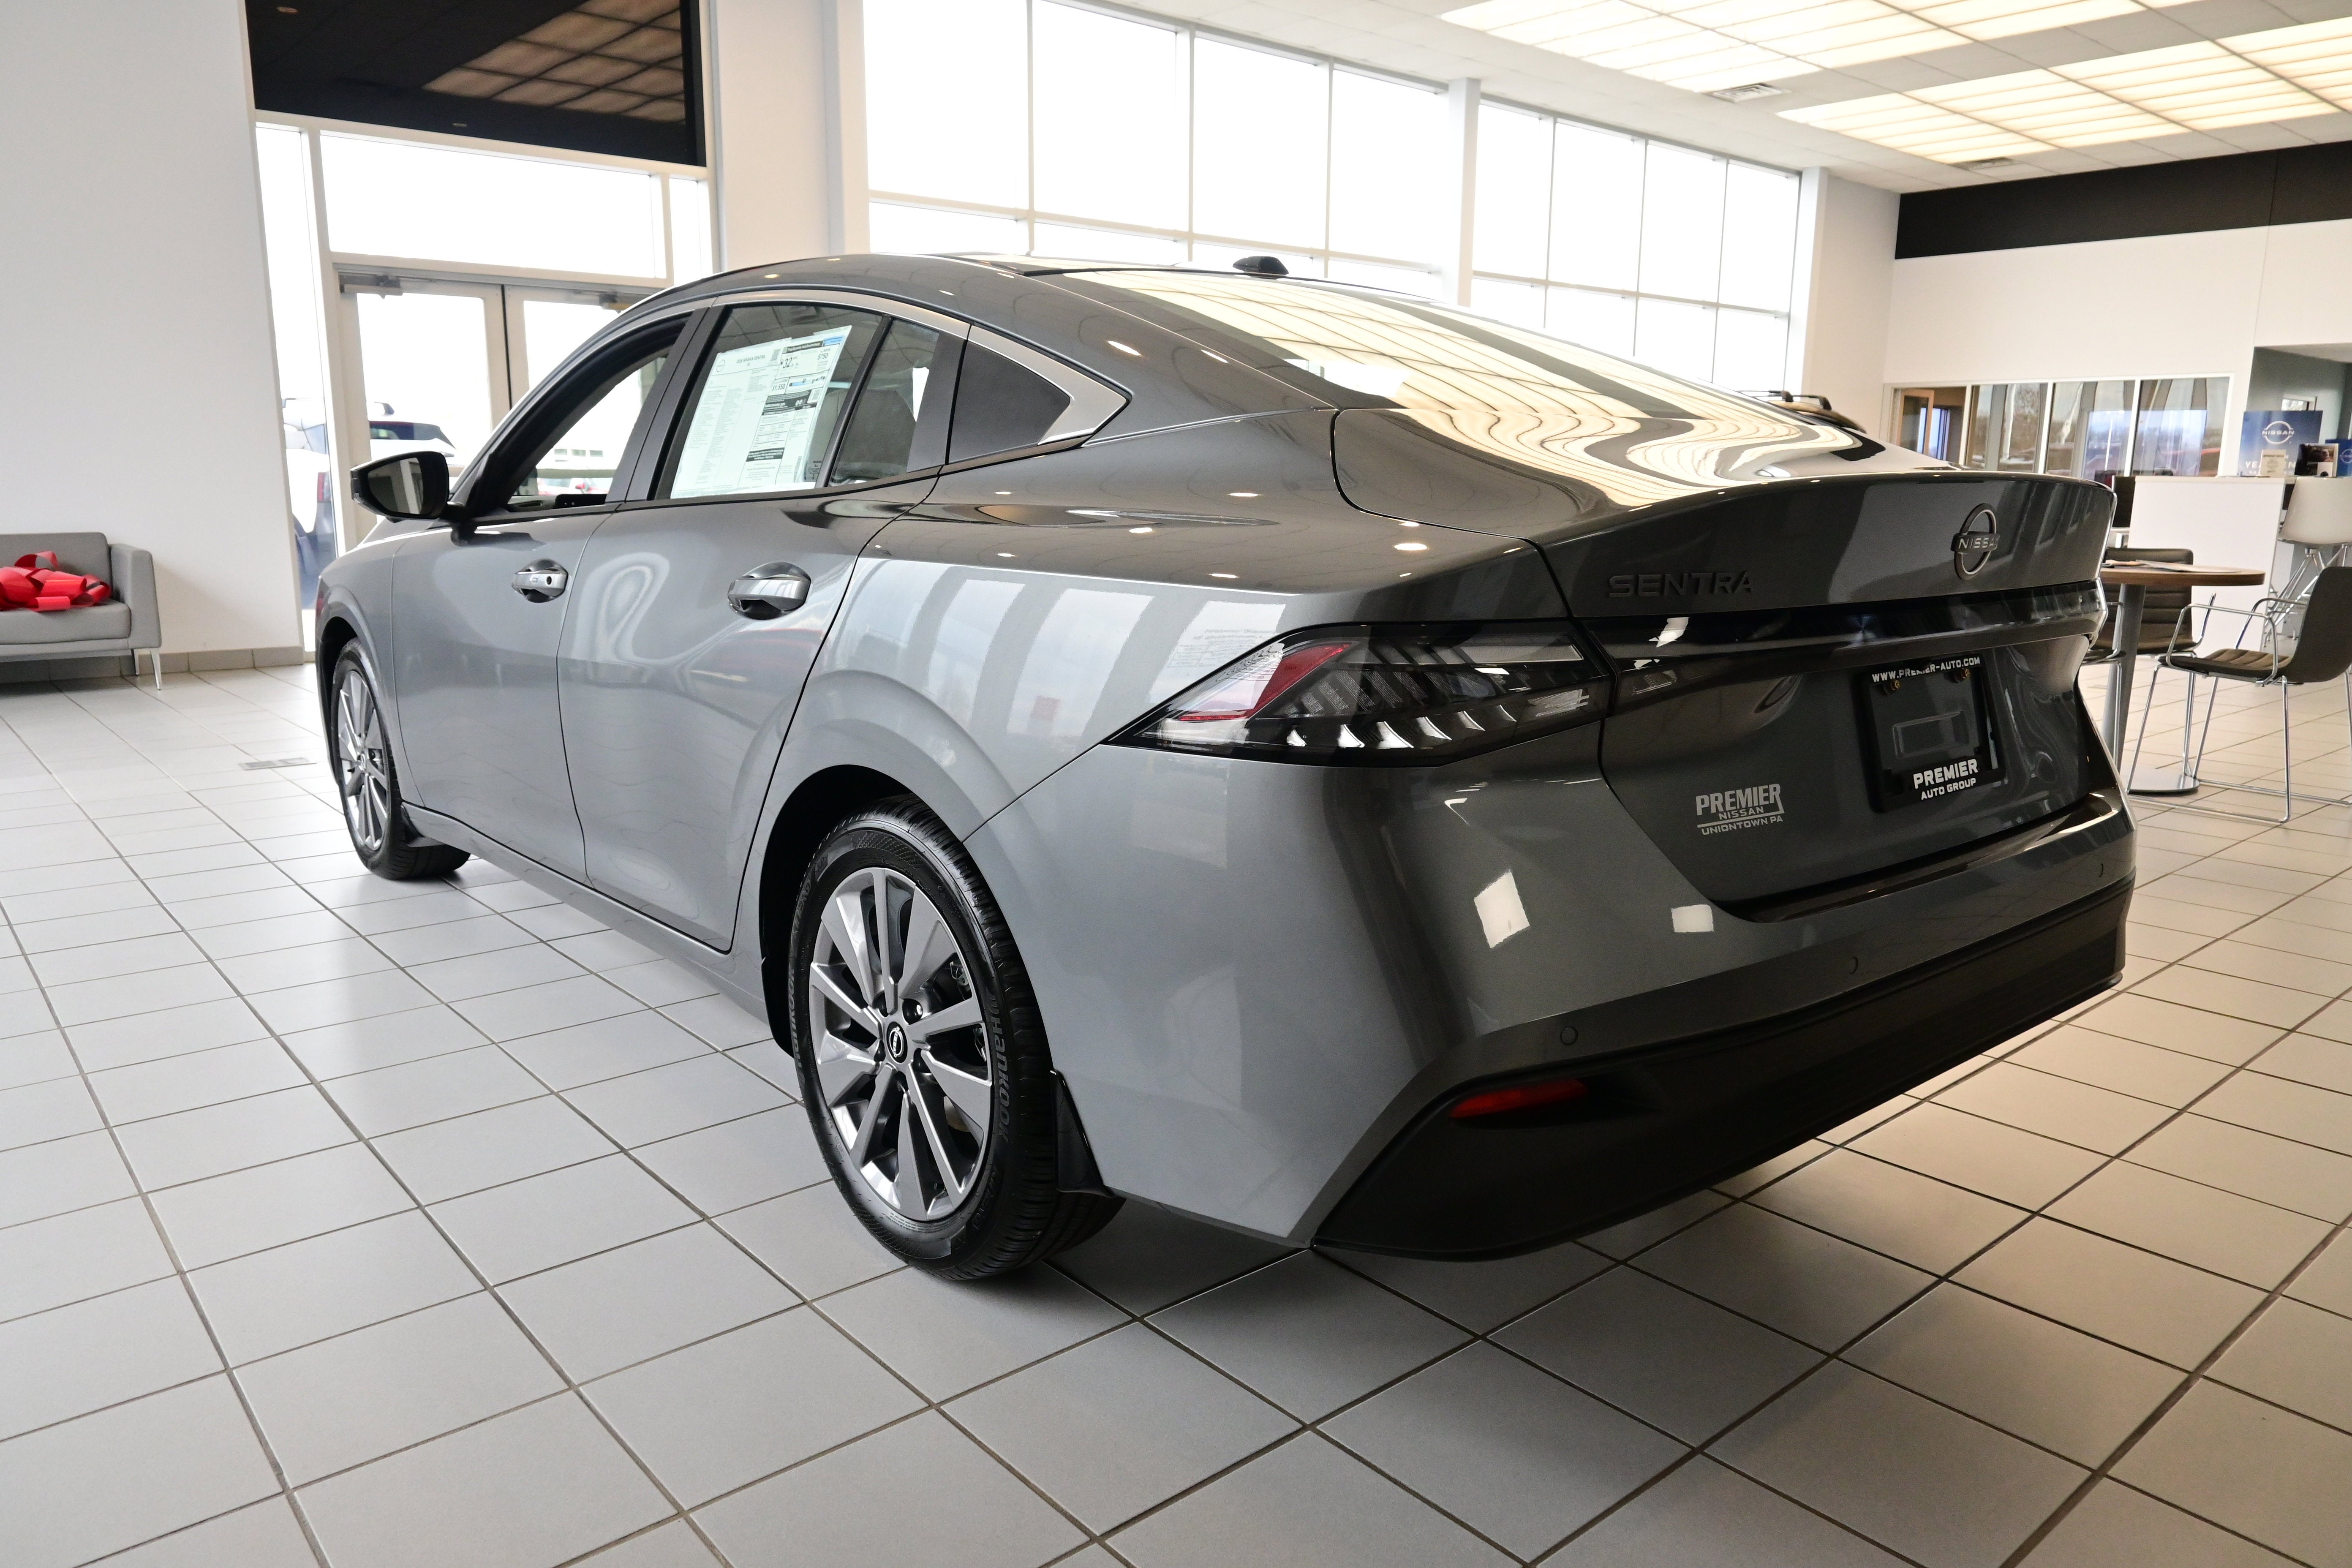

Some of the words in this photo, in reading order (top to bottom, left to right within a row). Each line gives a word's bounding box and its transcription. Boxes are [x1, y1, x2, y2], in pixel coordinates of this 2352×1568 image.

[1958, 537, 1999, 549] NISSAN
[1609, 571, 1753, 598] SENTRA
[1913, 758, 1979, 789] PREMIER
[1696, 783, 1783, 816] PREMIER
[1921, 786, 1945, 800] AUTO
[1946, 777, 1976, 793] GROUP
[1718, 806, 1764, 820] NISSAN
[1701, 817, 1768, 836] UNIONTOWN
[1770, 815, 1783, 824] PA
